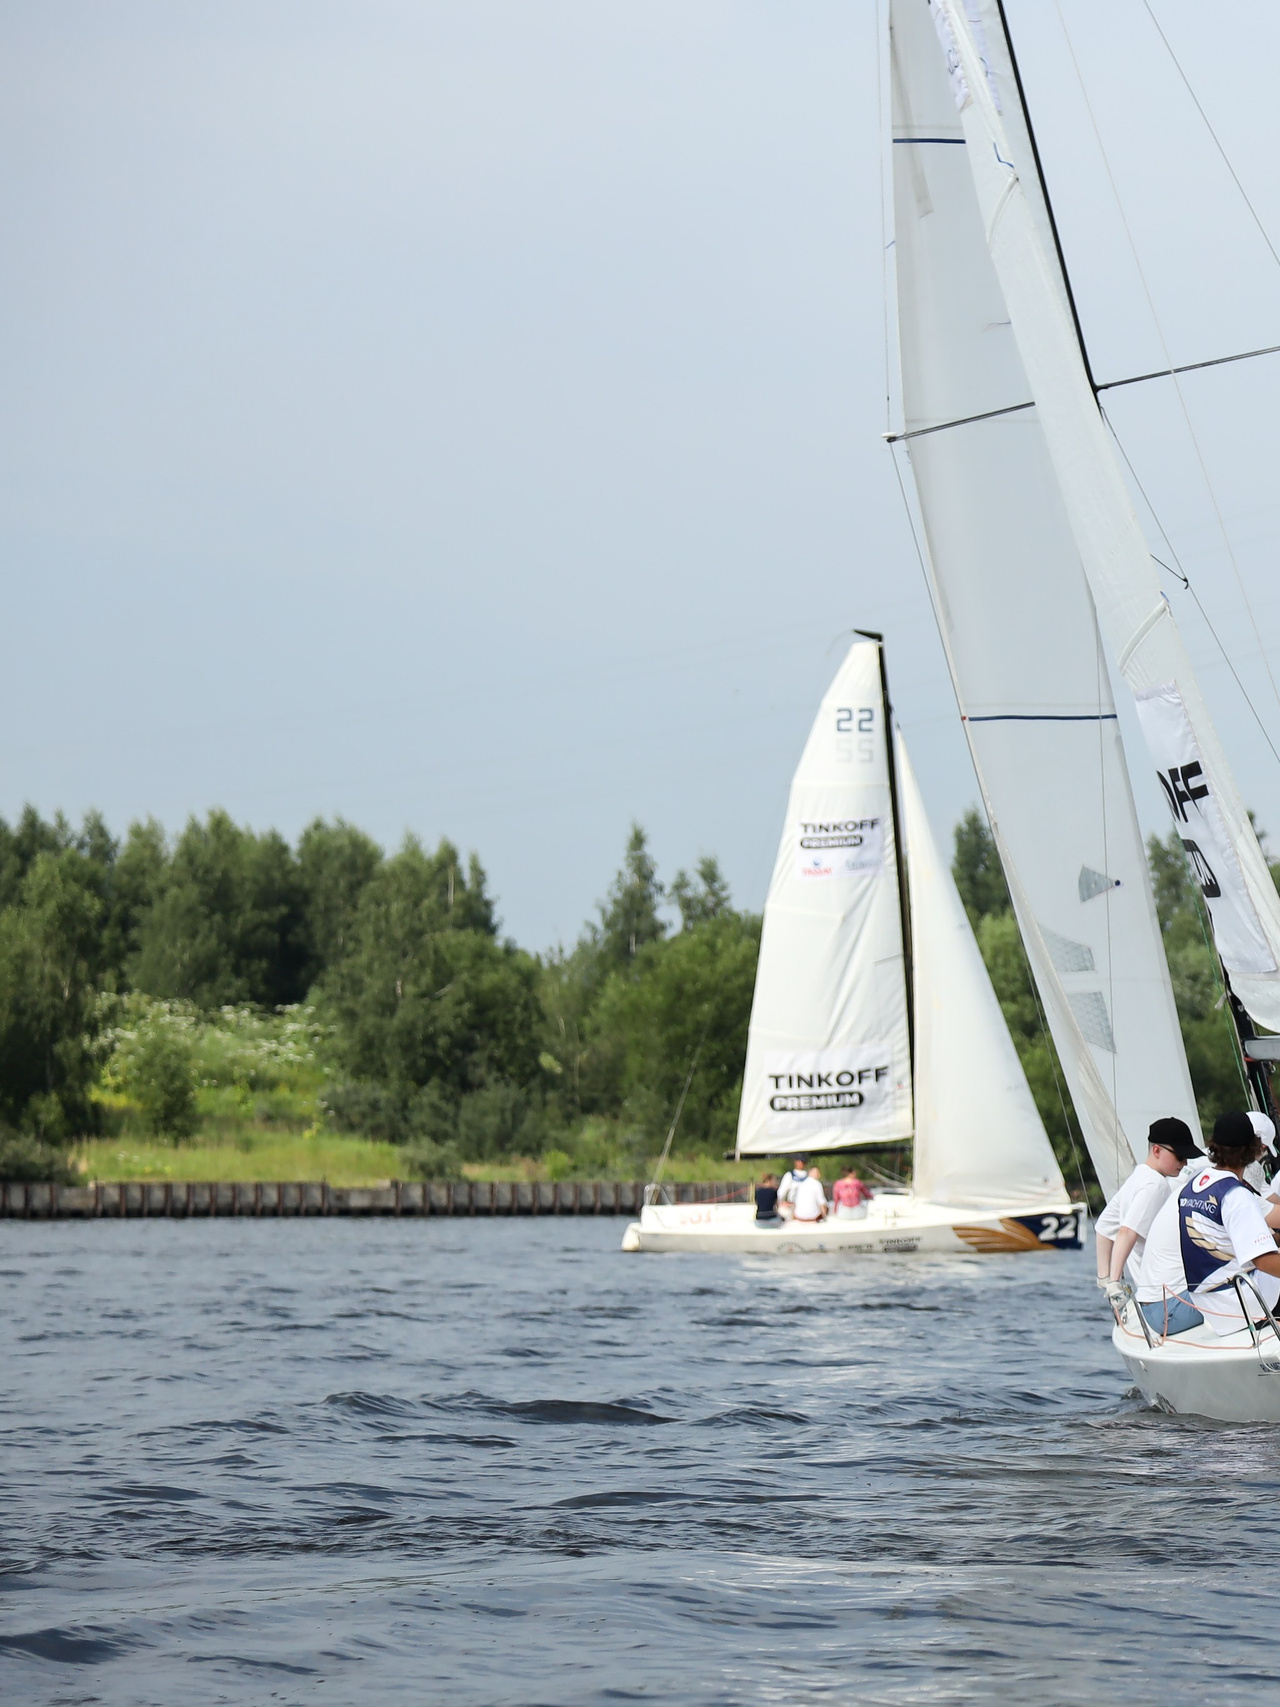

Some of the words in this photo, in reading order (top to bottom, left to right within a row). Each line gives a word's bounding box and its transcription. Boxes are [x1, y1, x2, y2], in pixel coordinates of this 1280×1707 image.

[836, 708, 873, 732] 22
[800, 818, 879, 833] TINKOFF
[768, 1065, 889, 1089] TINKOFF
[774, 1092, 860, 1110] PREMIUM
[1038, 1216, 1077, 1241] 22
